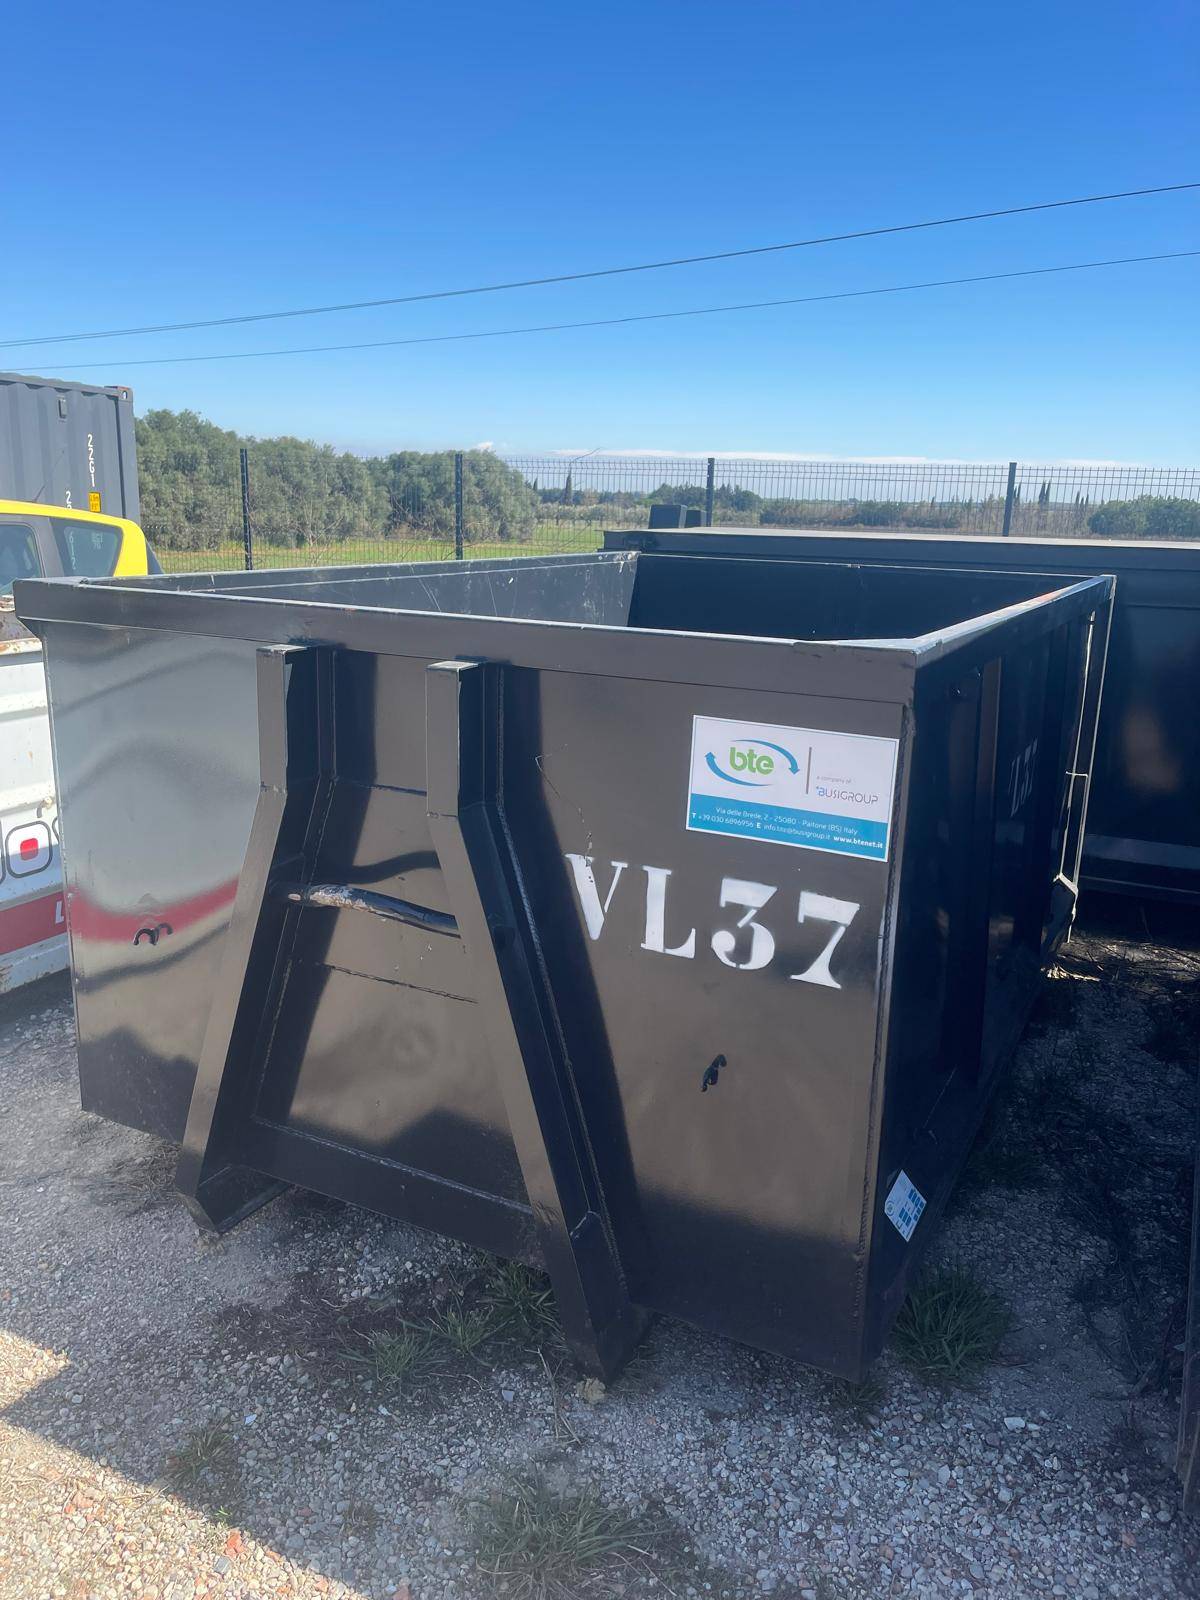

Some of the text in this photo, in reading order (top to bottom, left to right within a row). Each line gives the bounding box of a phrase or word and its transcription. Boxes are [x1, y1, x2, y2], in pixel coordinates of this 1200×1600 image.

[87, 433, 96, 488] 22G1
[729, 746, 775, 776] bte
[715, 806, 726, 815] Via
[843, 827, 859, 836] Italy
[833, 835, 884, 849] www.btenet.it
[564, 853, 861, 990] VL37
